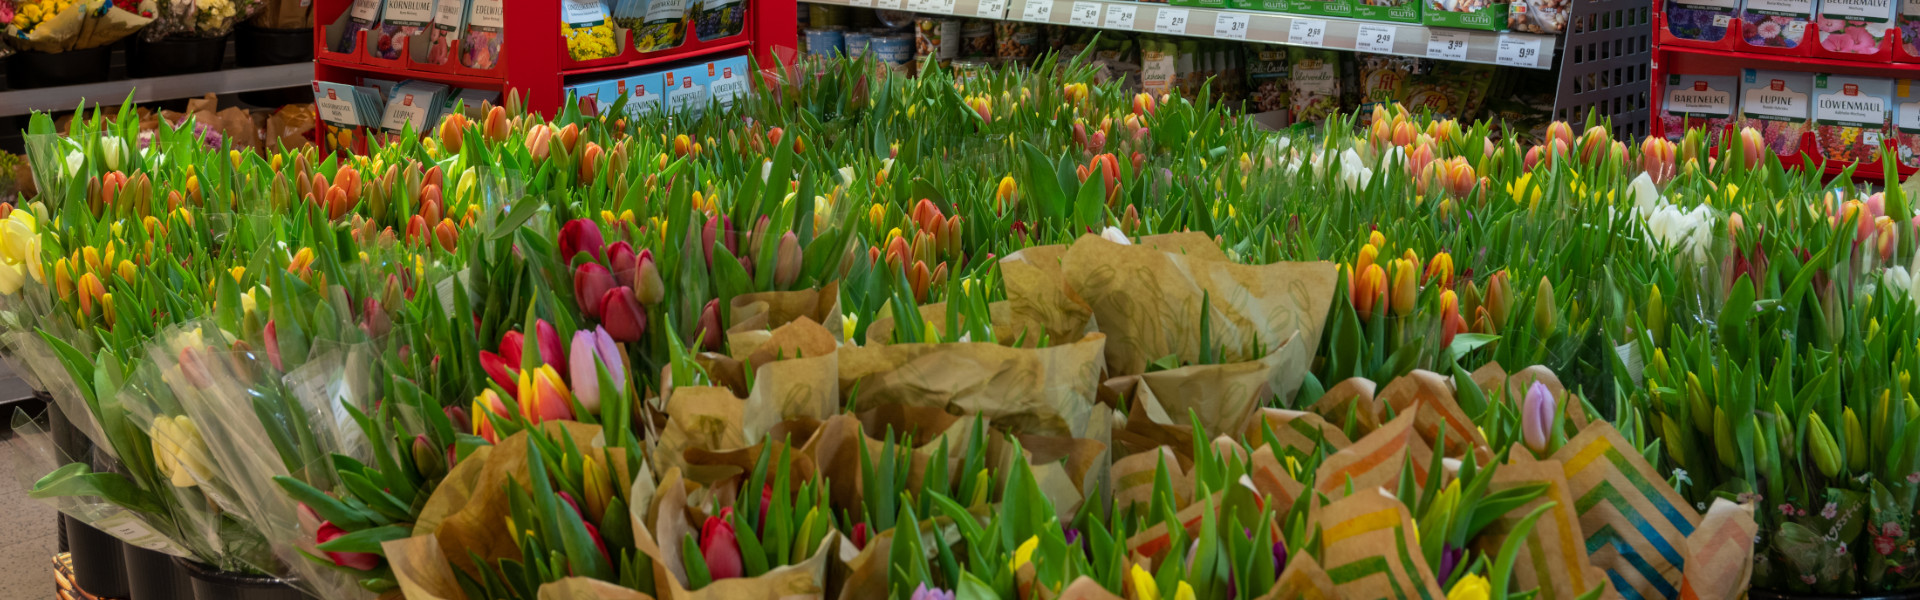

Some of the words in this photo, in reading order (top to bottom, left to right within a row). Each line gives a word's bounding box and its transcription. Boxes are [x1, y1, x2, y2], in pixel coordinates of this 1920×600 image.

[1390, 10, 1415, 18] KLUTH
[1462, 16, 1489, 24] KLUTH
[1674, 94, 1726, 104] BARTNELKE
[1760, 95, 1793, 106] LUPINE
[1820, 98, 1882, 112] LÖWENMAUL
